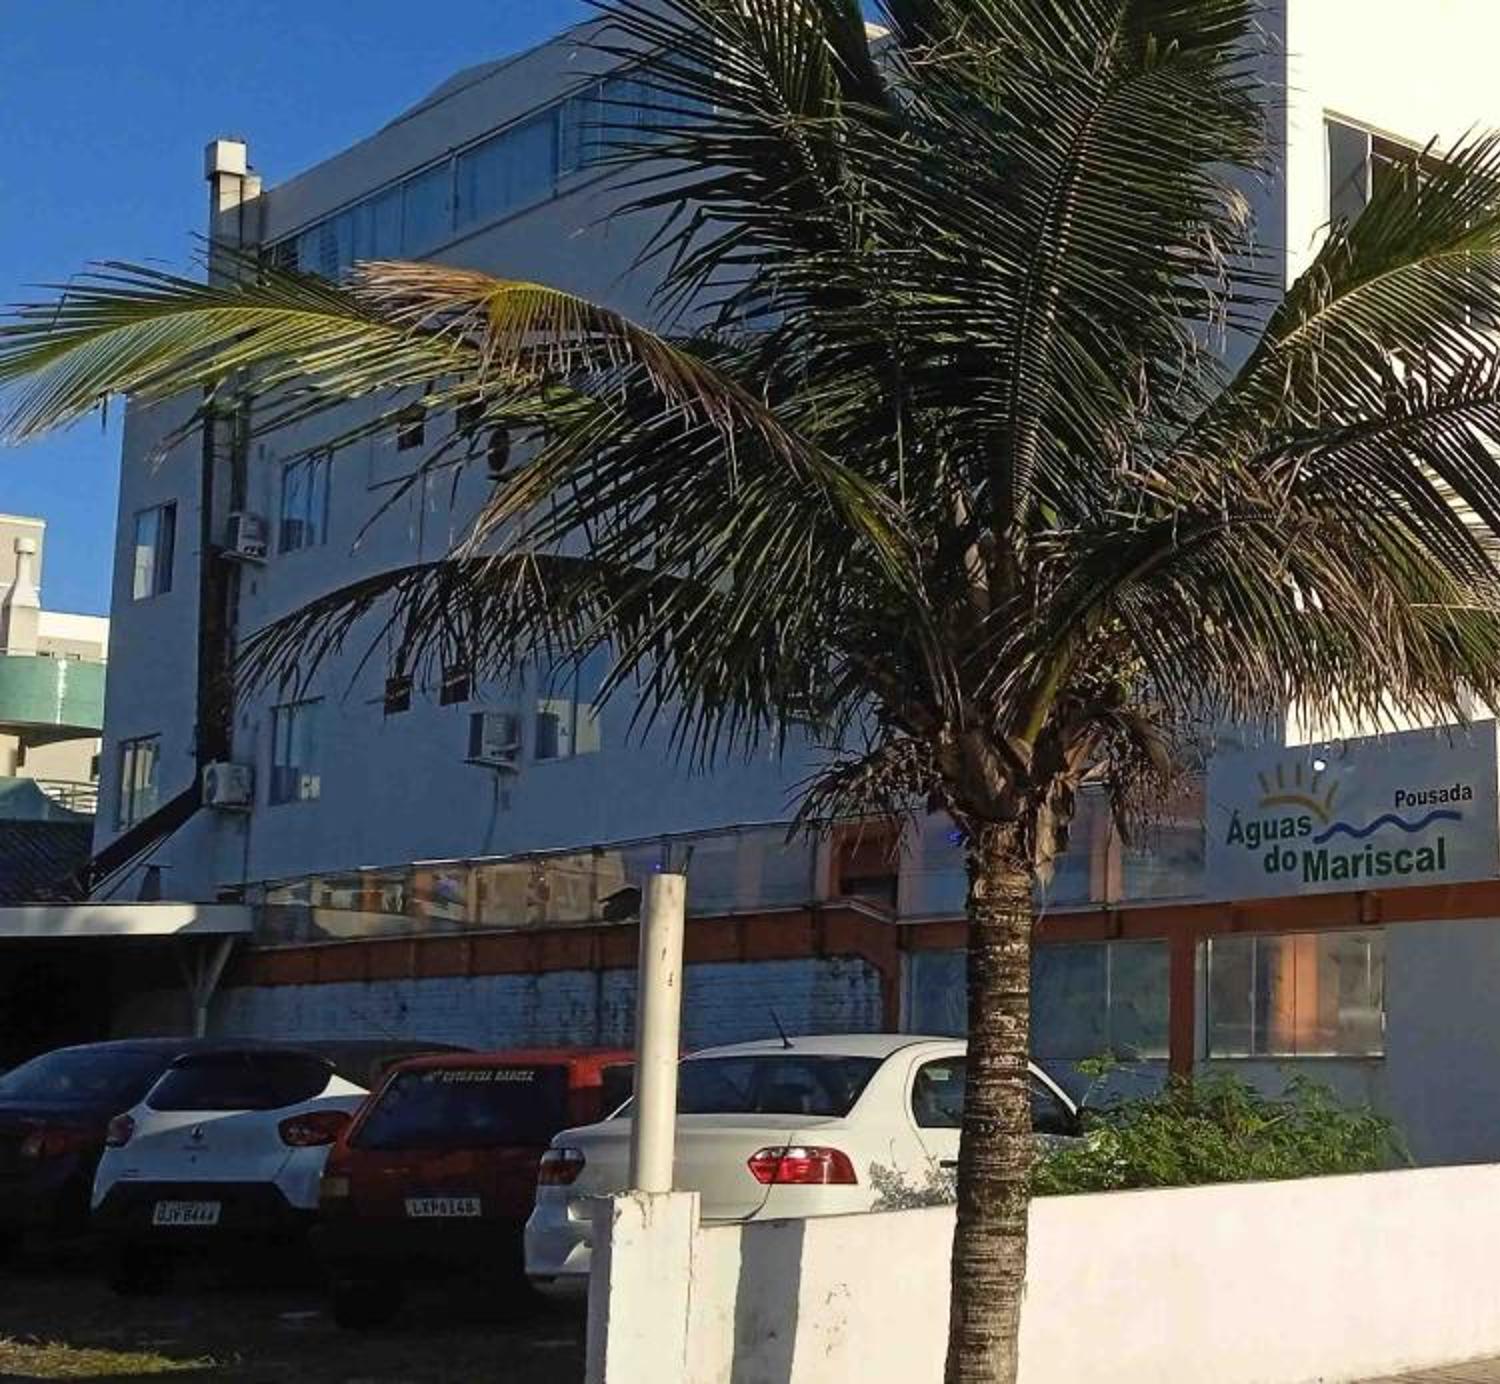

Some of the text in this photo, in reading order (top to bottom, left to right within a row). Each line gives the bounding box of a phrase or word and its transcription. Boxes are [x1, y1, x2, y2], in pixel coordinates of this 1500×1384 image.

[1395, 783, 1473, 809] Pousada
[1226, 809, 1312, 849] Águas
[1263, 837, 1446, 882] do Mariscal
